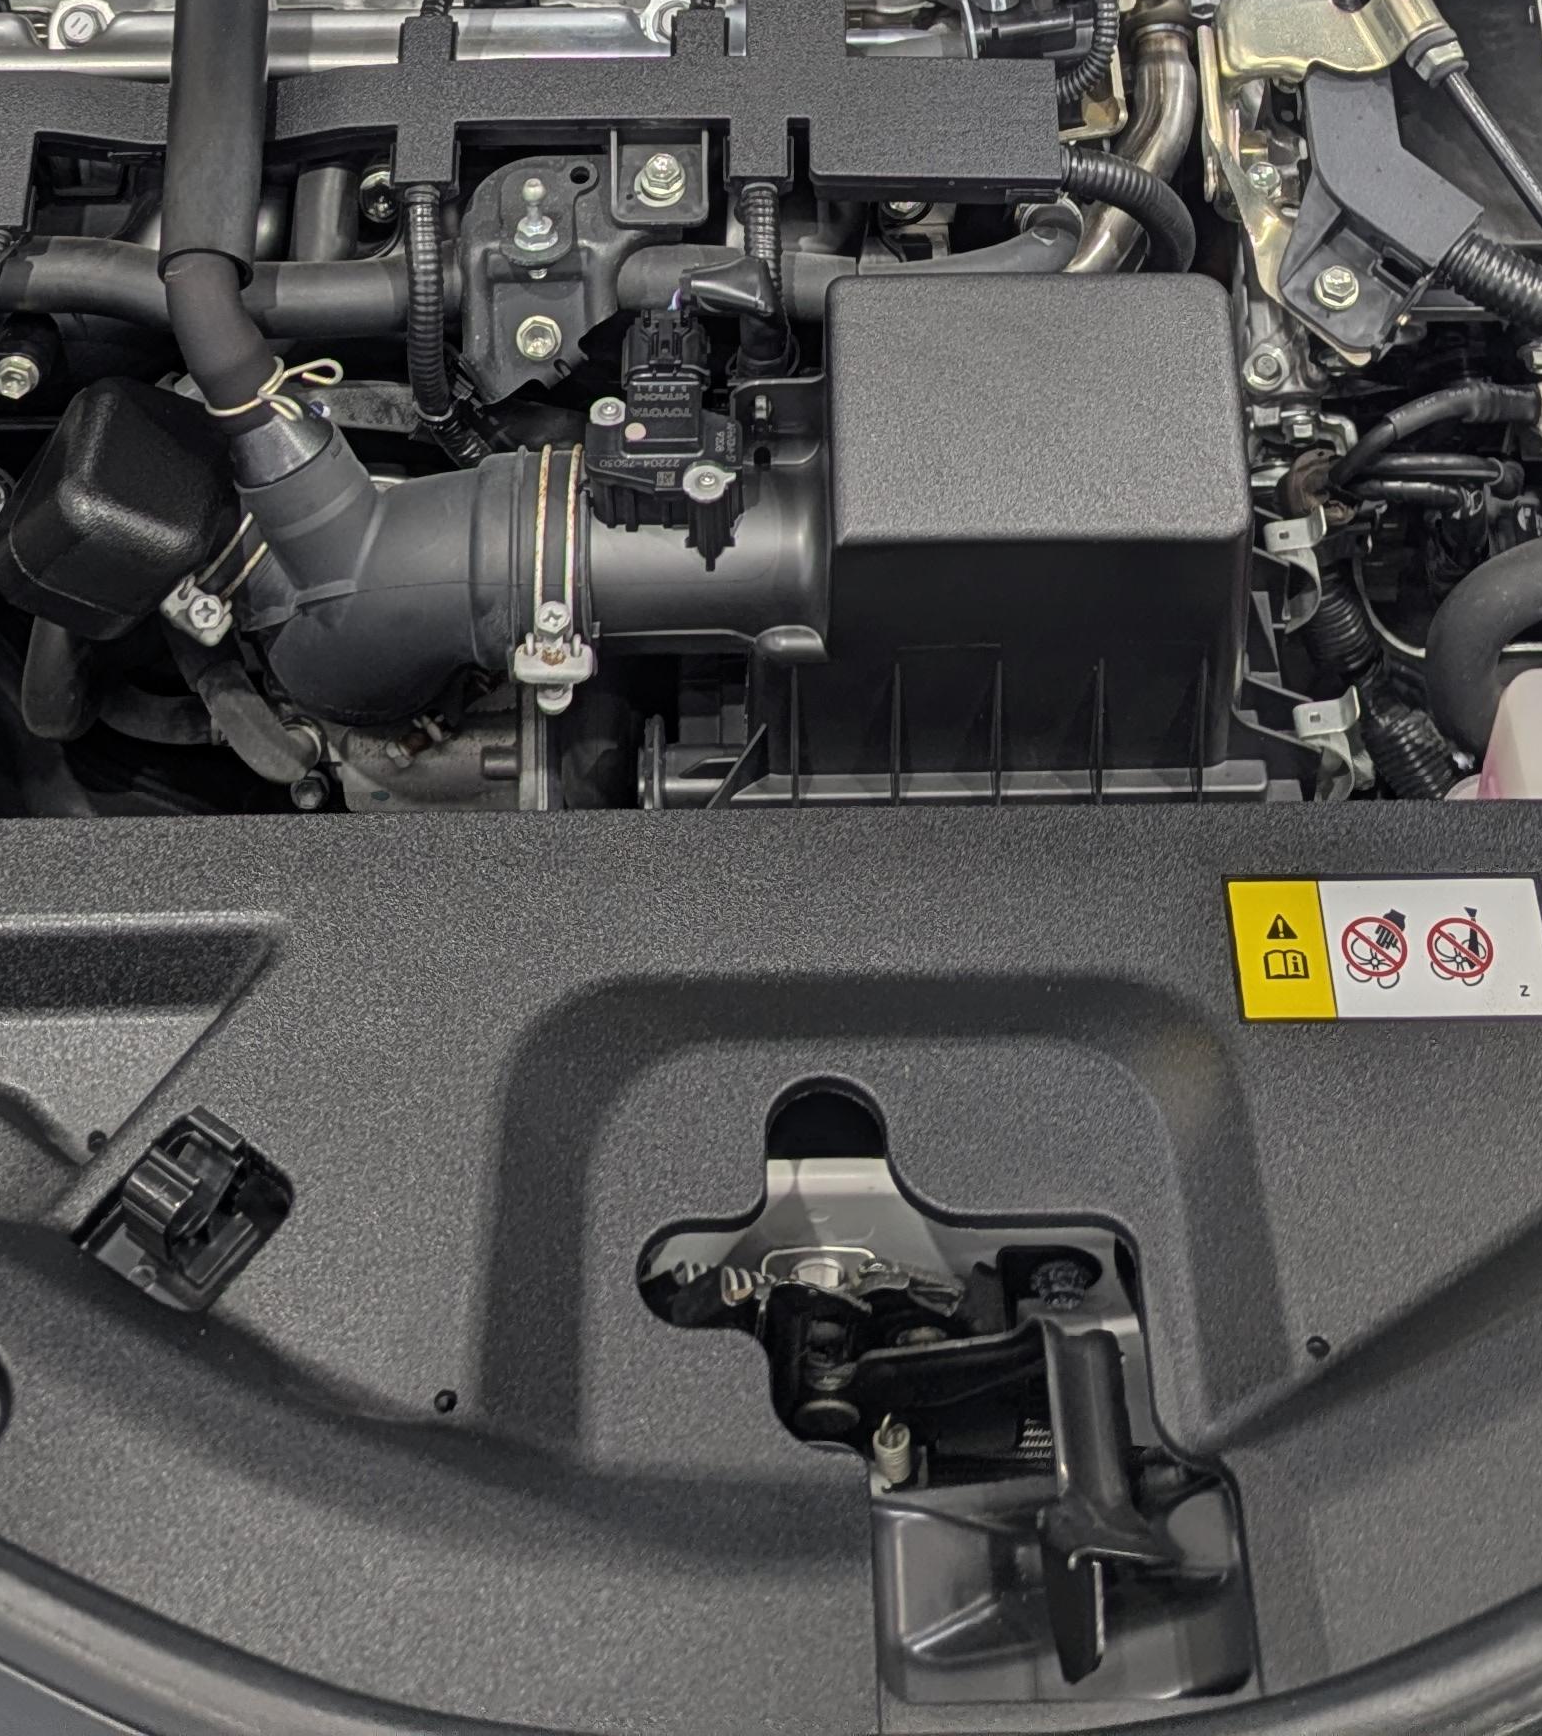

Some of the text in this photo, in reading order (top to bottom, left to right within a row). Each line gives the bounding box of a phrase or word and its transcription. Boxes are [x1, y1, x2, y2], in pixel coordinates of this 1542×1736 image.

[633, 392, 690, 401] HITACHI
[630, 407, 692, 418] TOYOTA
[1519, 985, 1530, 997] Z
